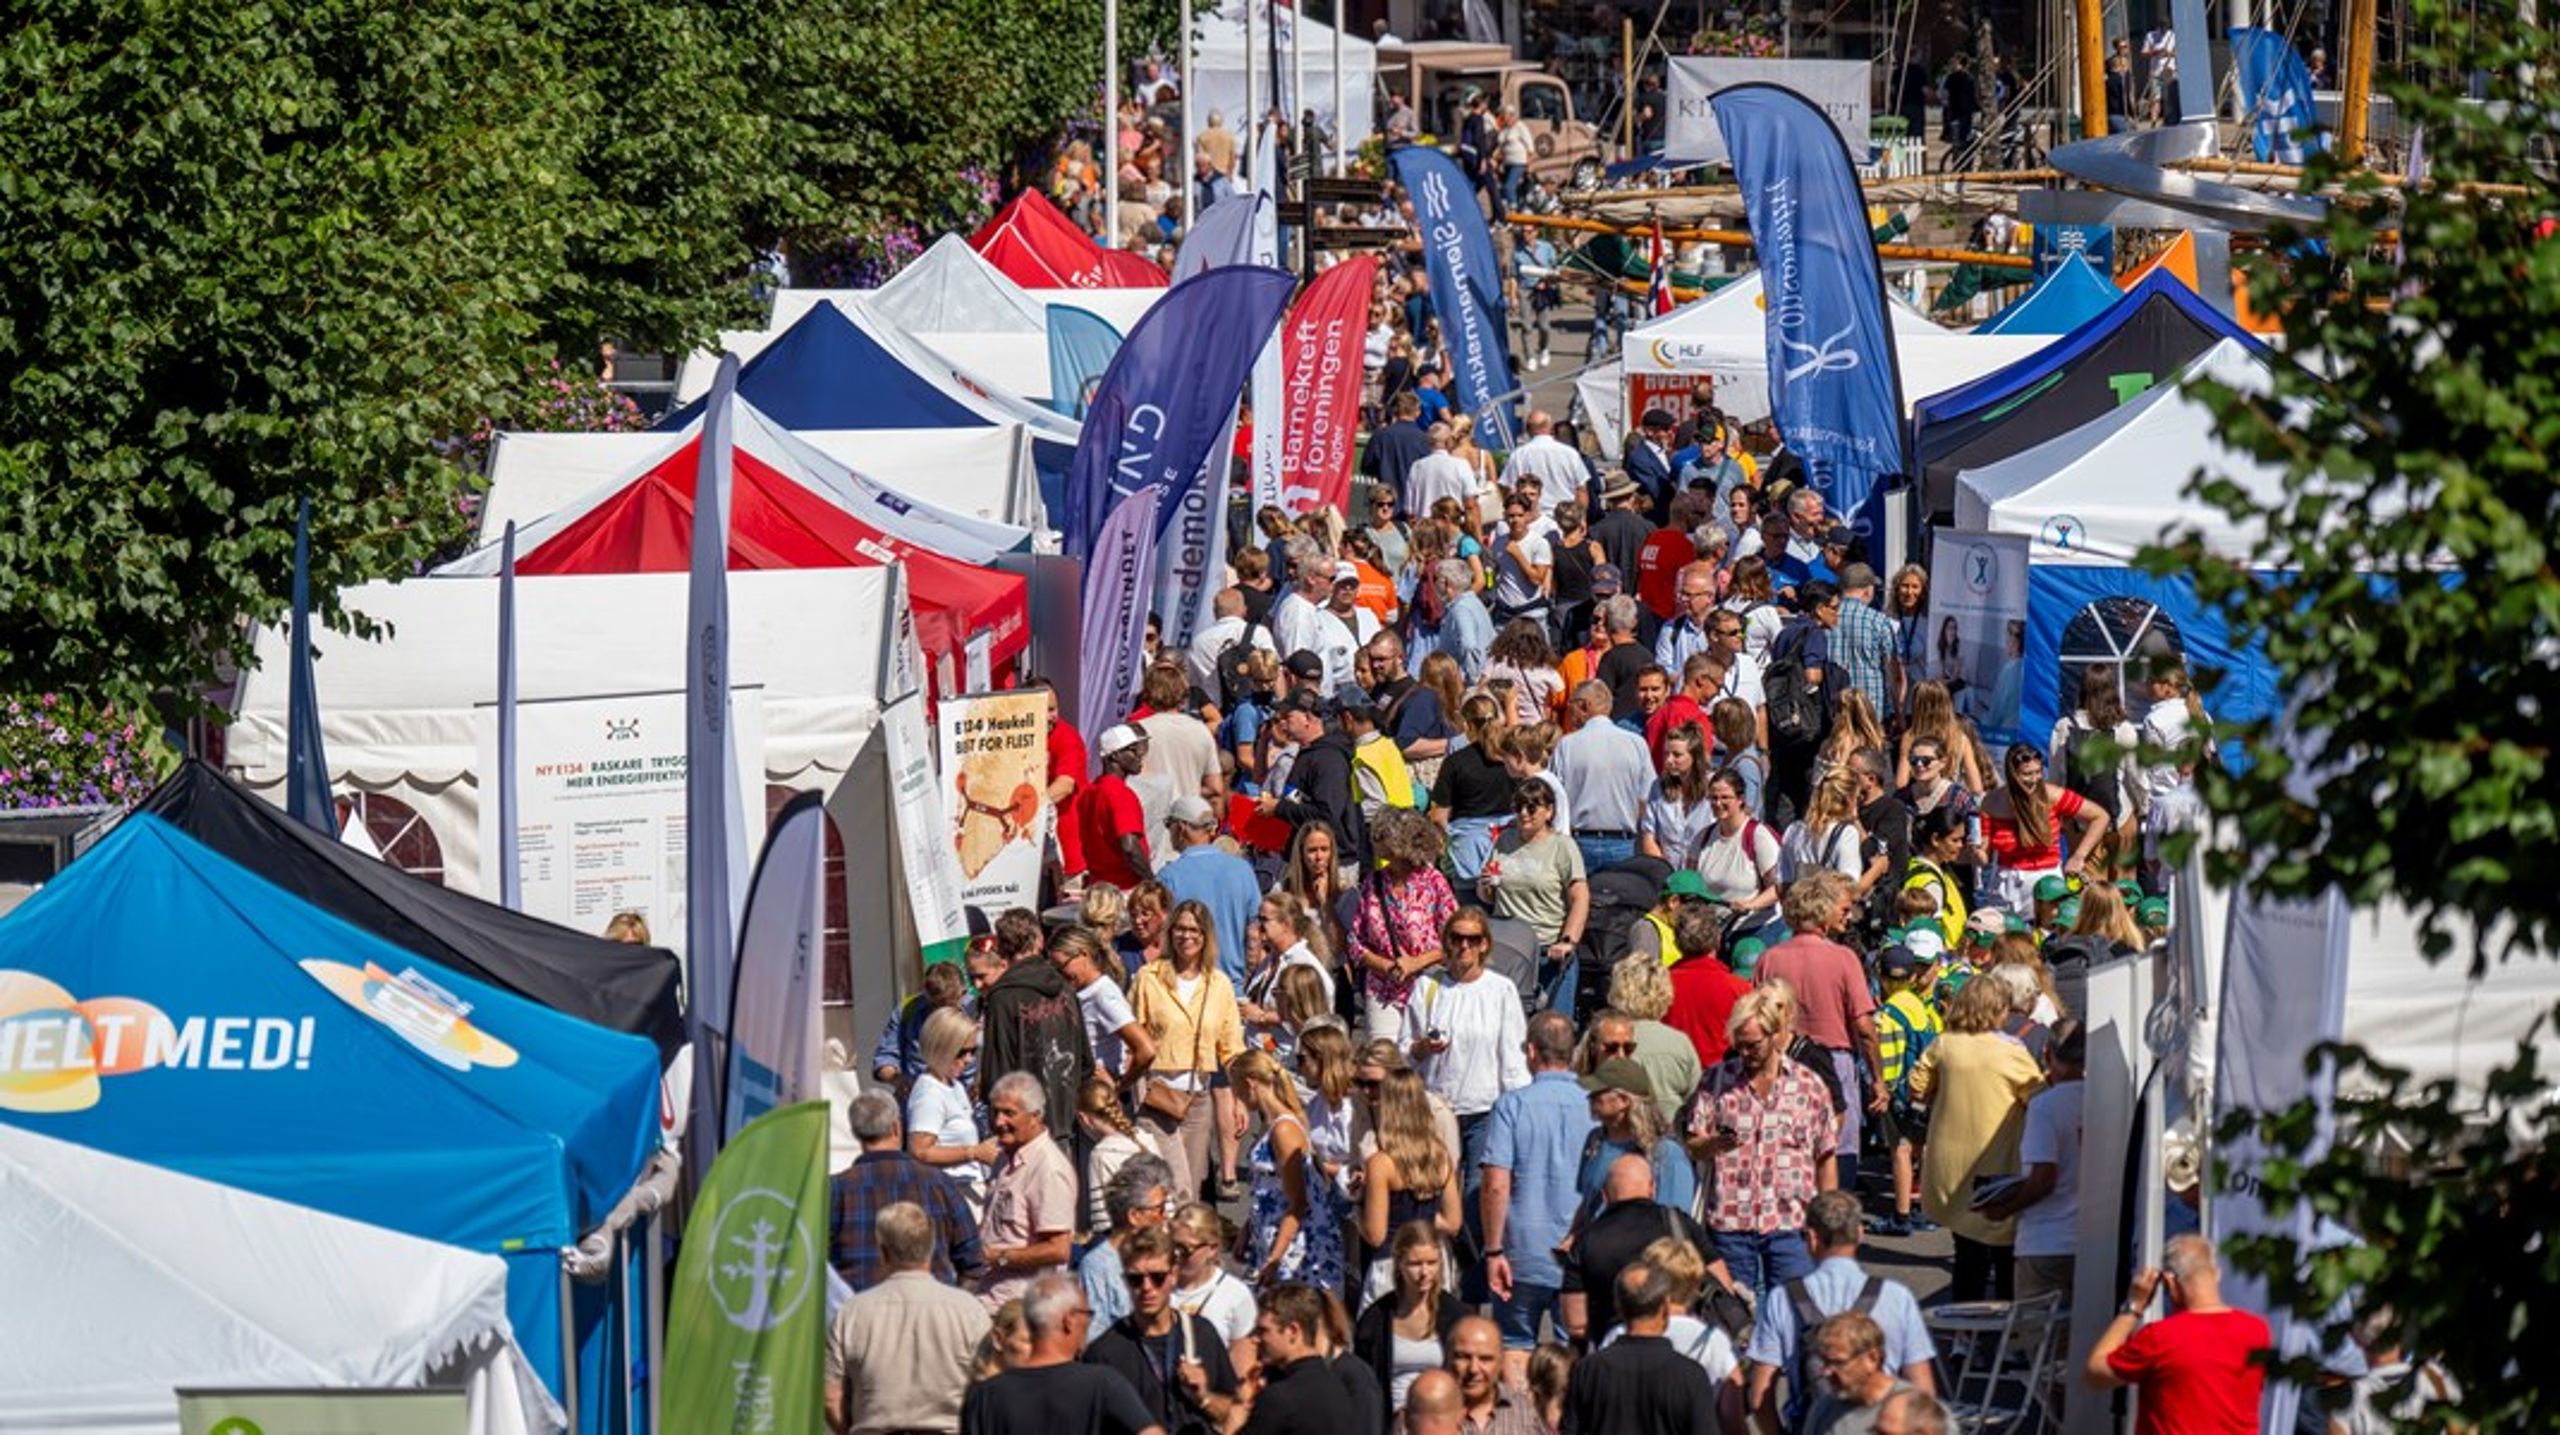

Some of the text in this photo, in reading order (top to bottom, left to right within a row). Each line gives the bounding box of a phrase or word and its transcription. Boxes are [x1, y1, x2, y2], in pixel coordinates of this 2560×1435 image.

[1679, 344, 1705, 357] HLF
[1283, 319, 1319, 472] Barnekreft
[1303, 318, 1344, 474] foreningen
[978, 736, 1003, 752] FOR
[1006, 733, 1035, 750] FLEST
[536, 765, 553, 776] NY
[556, 763, 583, 775] E134
[591, 758, 643, 772] RASKARE
[567, 777, 594, 788] MEIR
[142, 1016, 315, 1070] MED!
